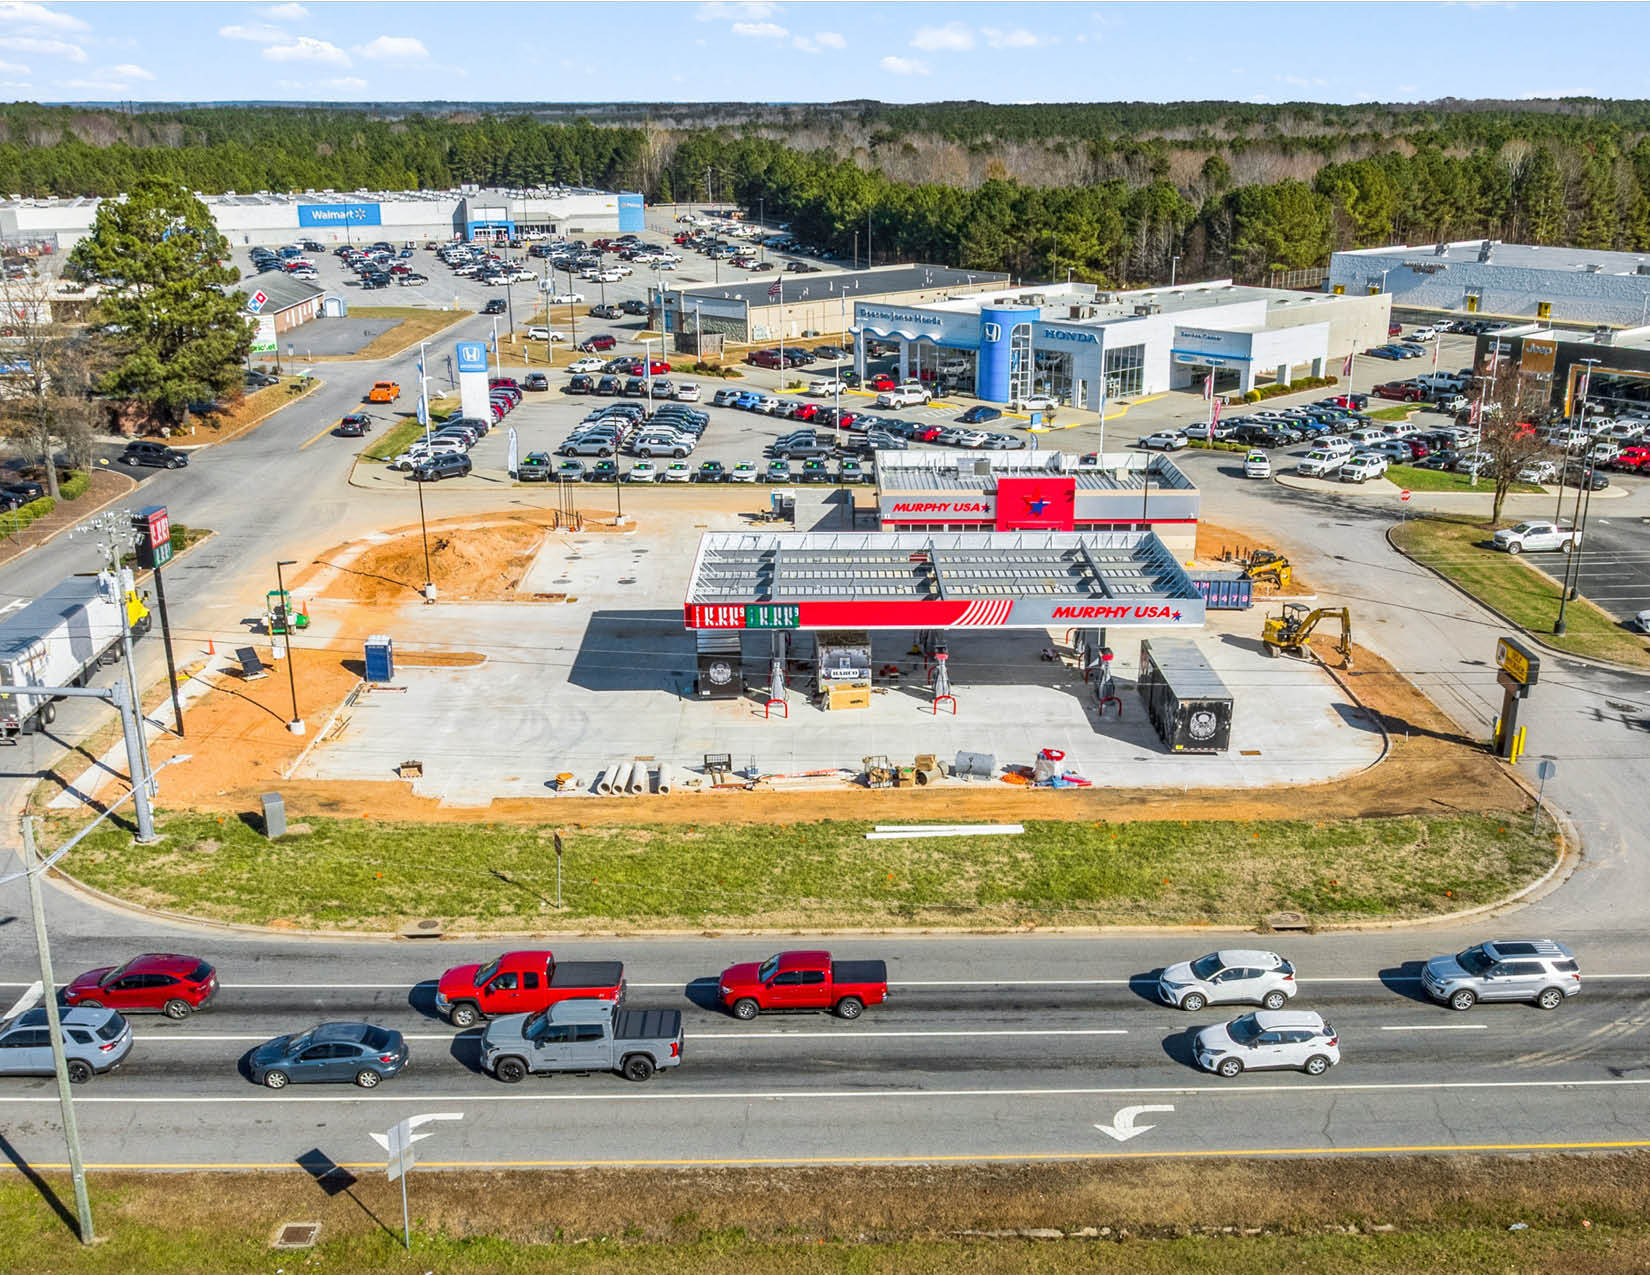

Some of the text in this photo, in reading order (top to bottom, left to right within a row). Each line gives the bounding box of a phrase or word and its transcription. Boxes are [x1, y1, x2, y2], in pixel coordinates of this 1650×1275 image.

[312, 209, 353, 220] Walmart
[1043, 328, 1100, 345] HONDA
[892, 503, 980, 513] MURPHY USA
[1051, 606, 1170, 618] MURPHY USA
